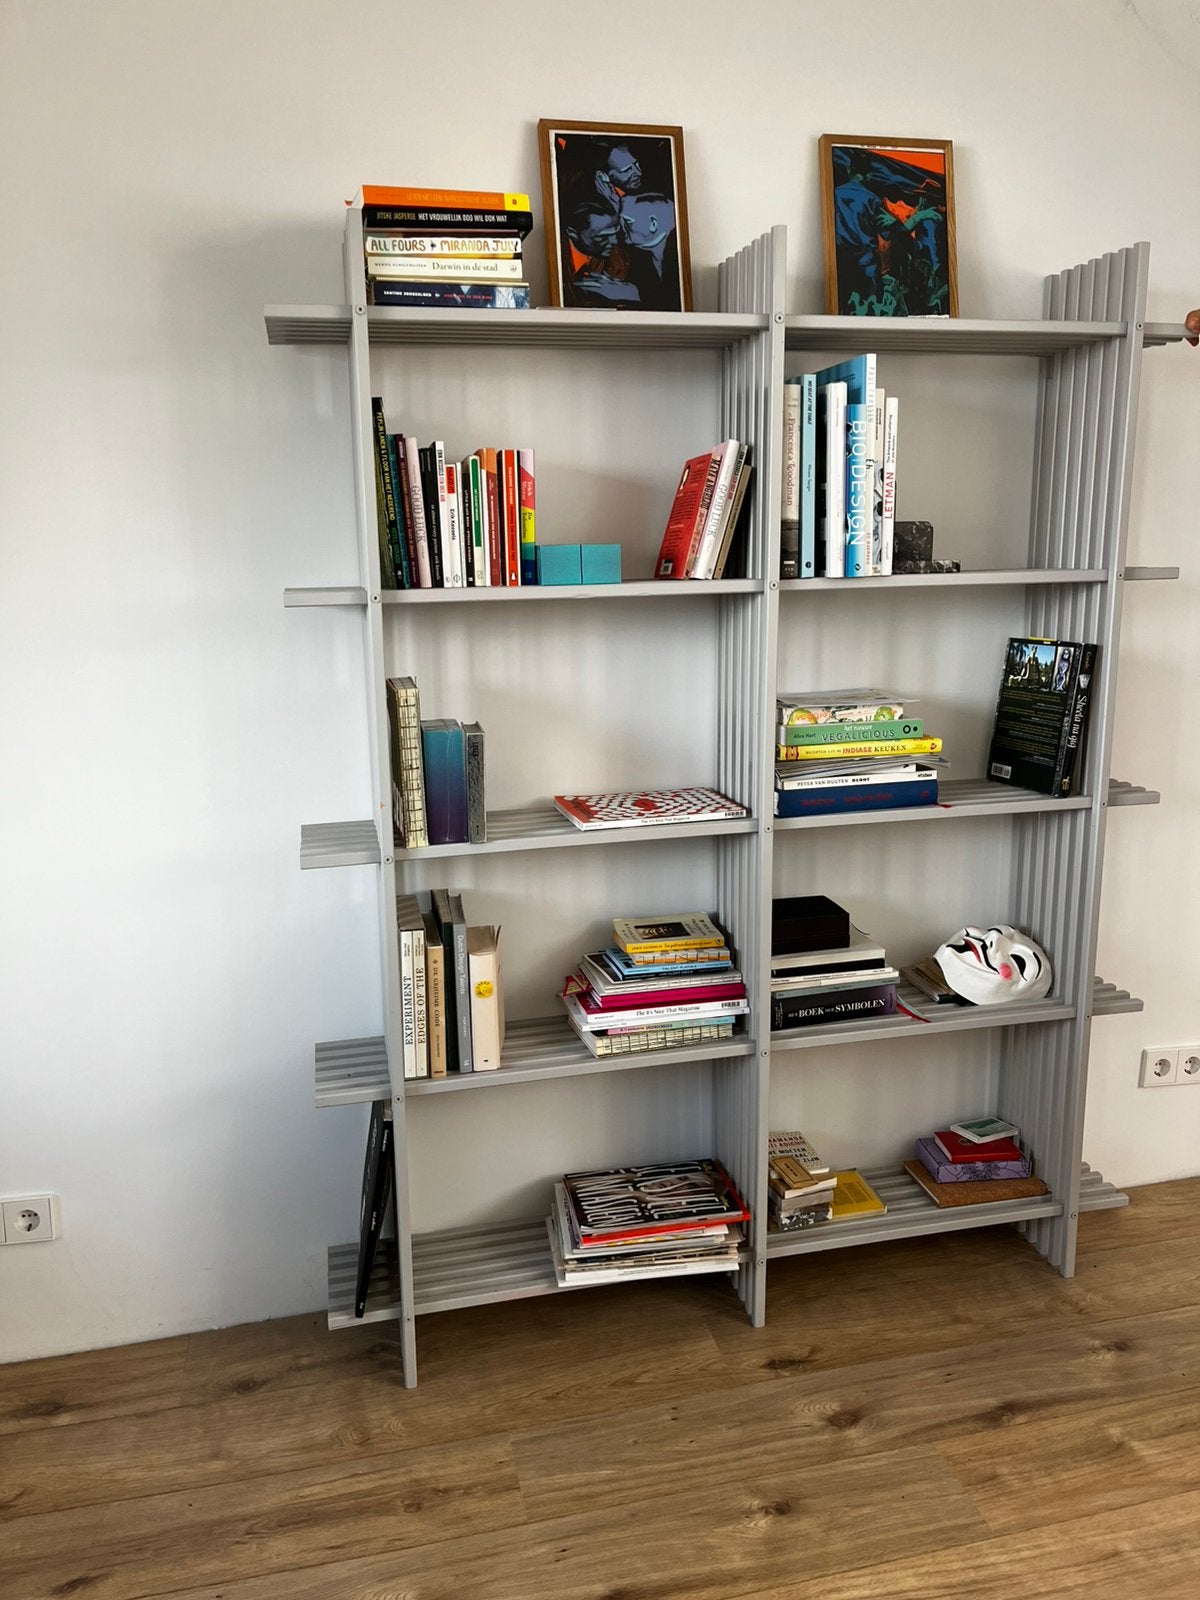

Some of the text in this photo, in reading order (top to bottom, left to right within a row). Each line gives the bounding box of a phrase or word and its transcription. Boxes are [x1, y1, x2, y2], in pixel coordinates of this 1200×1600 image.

[418, 213, 428, 221] HET
[429, 214, 462, 222] VROUWELIJK
[474, 214, 484, 222] WIL
[496, 215, 508, 223] WAT
[371, 240, 518, 252] ALL FOURS MIRANDA JULY
[432, 262, 461, 270] Darwin
[473, 263, 482, 271] de
[483, 264, 498, 272] stad
[786, 418, 796, 506] Francesca Woodman
[884, 472, 894, 519] LETMAN
[386, 494, 395, 520] NEDEREND
[411, 486, 427, 543] GOOD LUCK
[707, 484, 728, 538] GOOD LUCK
[1073, 695, 1087, 724] Sheela
[821, 730, 895, 742] VEGALICIOUS
[1067, 734, 1079, 748] gig
[874, 744, 907, 753] KEUKEN
[456, 935, 465, 952] Dutch
[433, 967, 438, 976] DE
[457, 953, 465, 973] Design
[404, 976, 413, 1045] EXPERIMENT
[416, 968, 425, 1044] EDGES OF THE
[799, 1007, 825, 1018] BOEK
[835, 999, 885, 1012] SYMBOLEN
